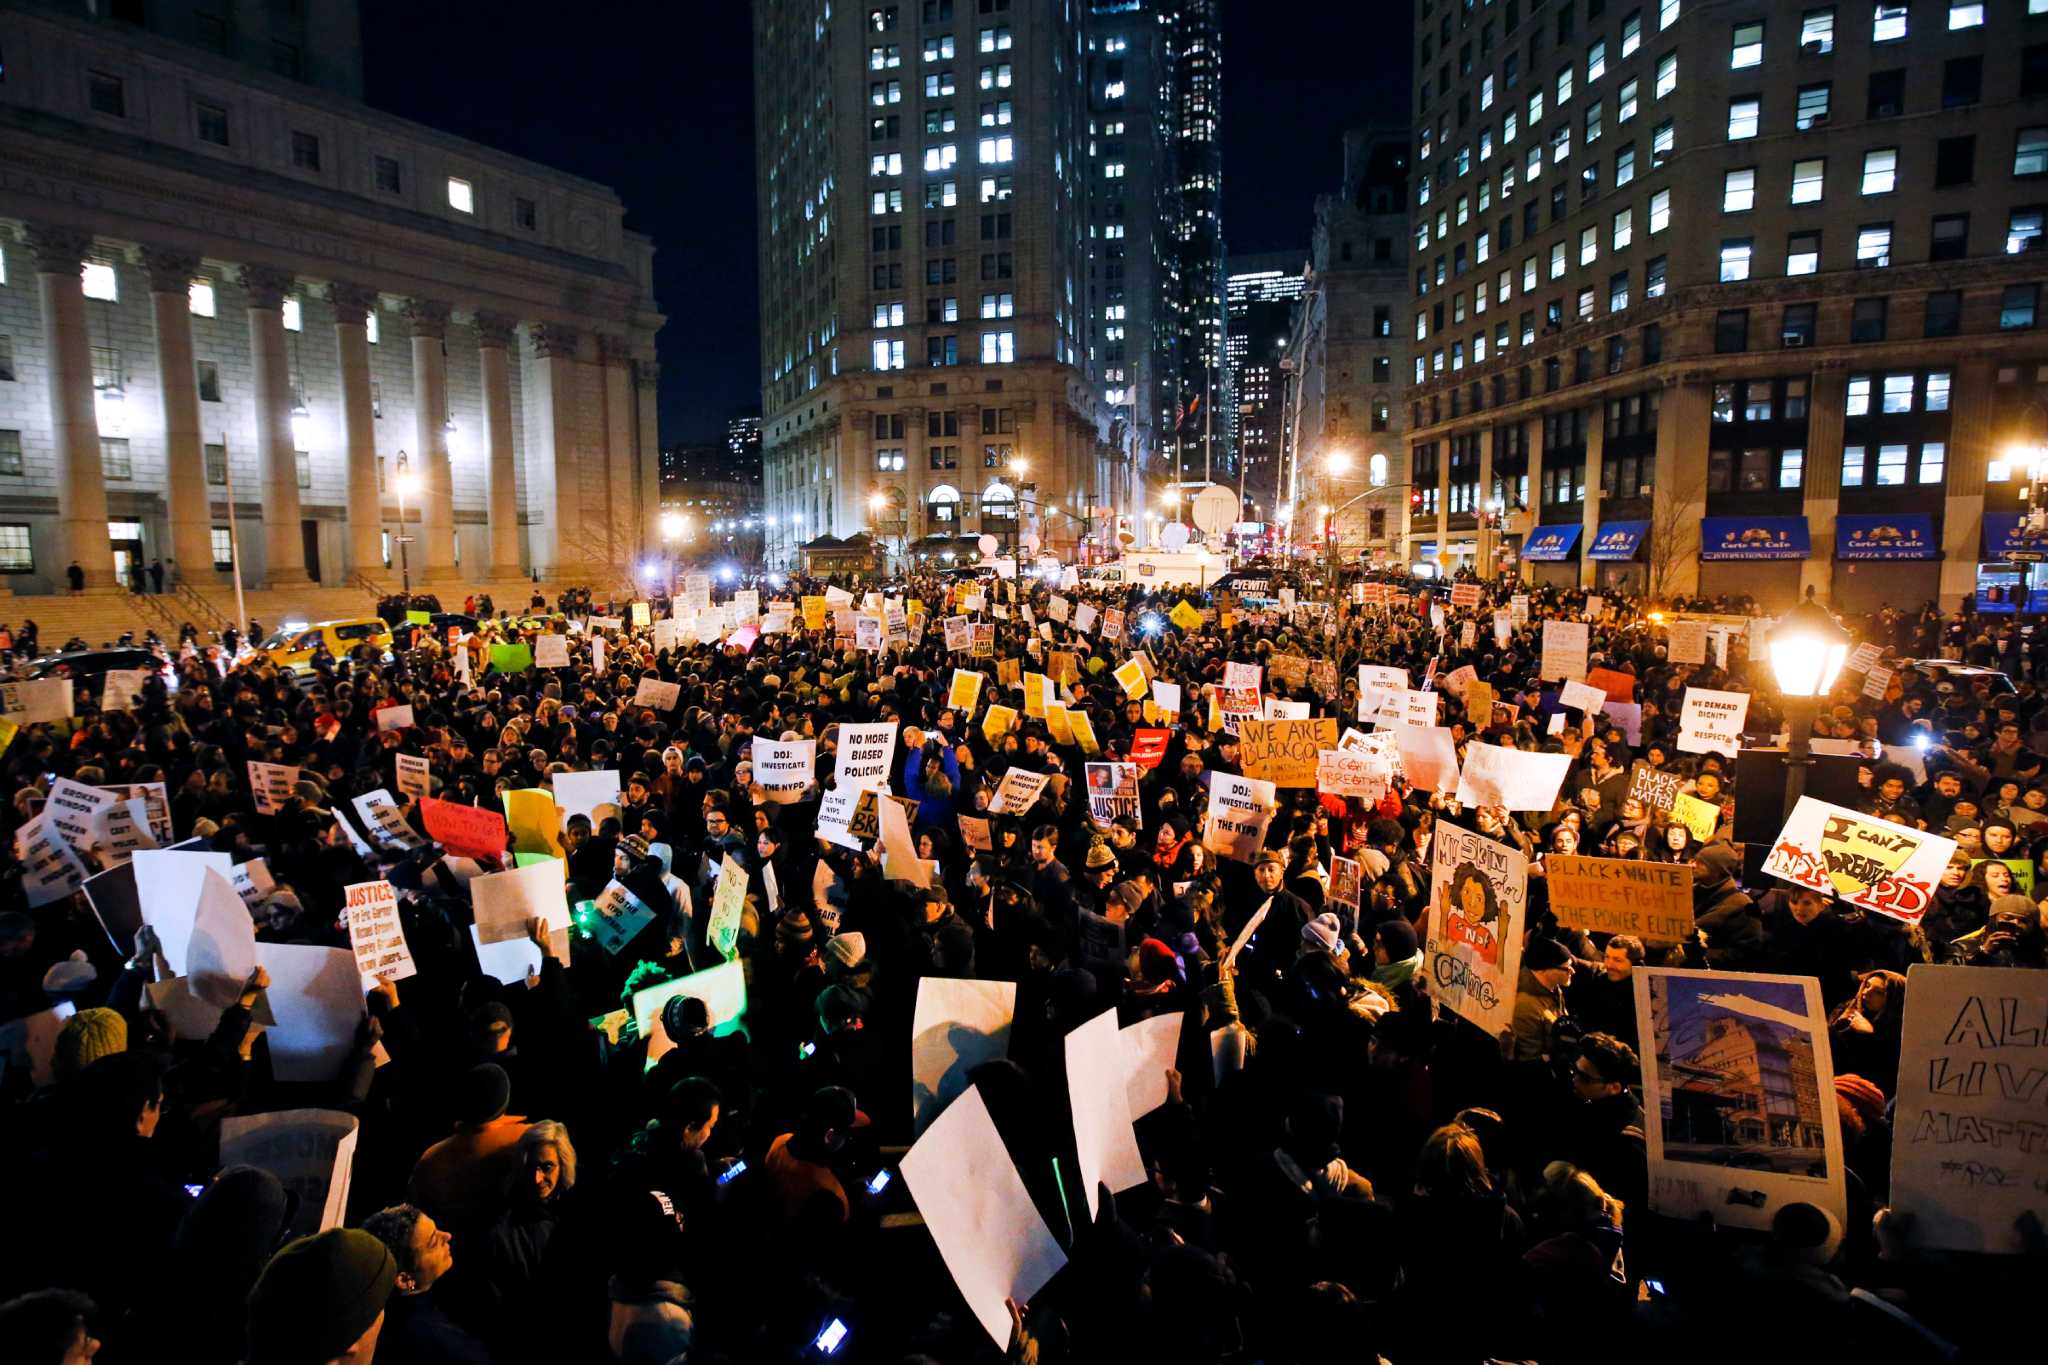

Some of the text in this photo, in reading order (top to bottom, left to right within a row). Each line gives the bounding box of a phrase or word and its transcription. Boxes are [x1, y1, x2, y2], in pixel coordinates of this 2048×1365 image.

[1704, 701, 1738, 711] DEMAND
[1698, 711, 1728, 720] DIGNITY
[850, 733, 889, 745] NO MORE
[1244, 720, 1328, 743] WE ARE
[1694, 731, 1726, 742] RESPECT
[774, 751, 793, 760] DOJ:
[851, 749, 883, 761] BIASED
[1320, 754, 1334, 768] I
[761, 761, 806, 770] INVESTIGATE
[844, 765, 884, 778] POLICING
[1637, 768, 1681, 789] BLACK
[764, 782, 806, 792] THE NYPD
[1232, 784, 1252, 797] DOJ:
[1636, 779, 1673, 799] LIVES
[1219, 796, 1263, 813] INVESTIGATE
[1629, 787, 1673, 811] MATTER
[1093, 797, 1137, 819] JUSTICE
[1217, 819, 1234, 831] THE
[1824, 817, 1917, 853] I CAN'T
[1549, 858, 1610, 880] BLACK
[1623, 864, 1682, 887] WHITE
[348, 884, 394, 908] JUSTICE
[1551, 880, 1611, 902] UNITE
[1623, 886, 1685, 911] FIGHT
[1864, 879, 1927, 914] PD
[1556, 905, 1689, 937] THE POWER ELITE
